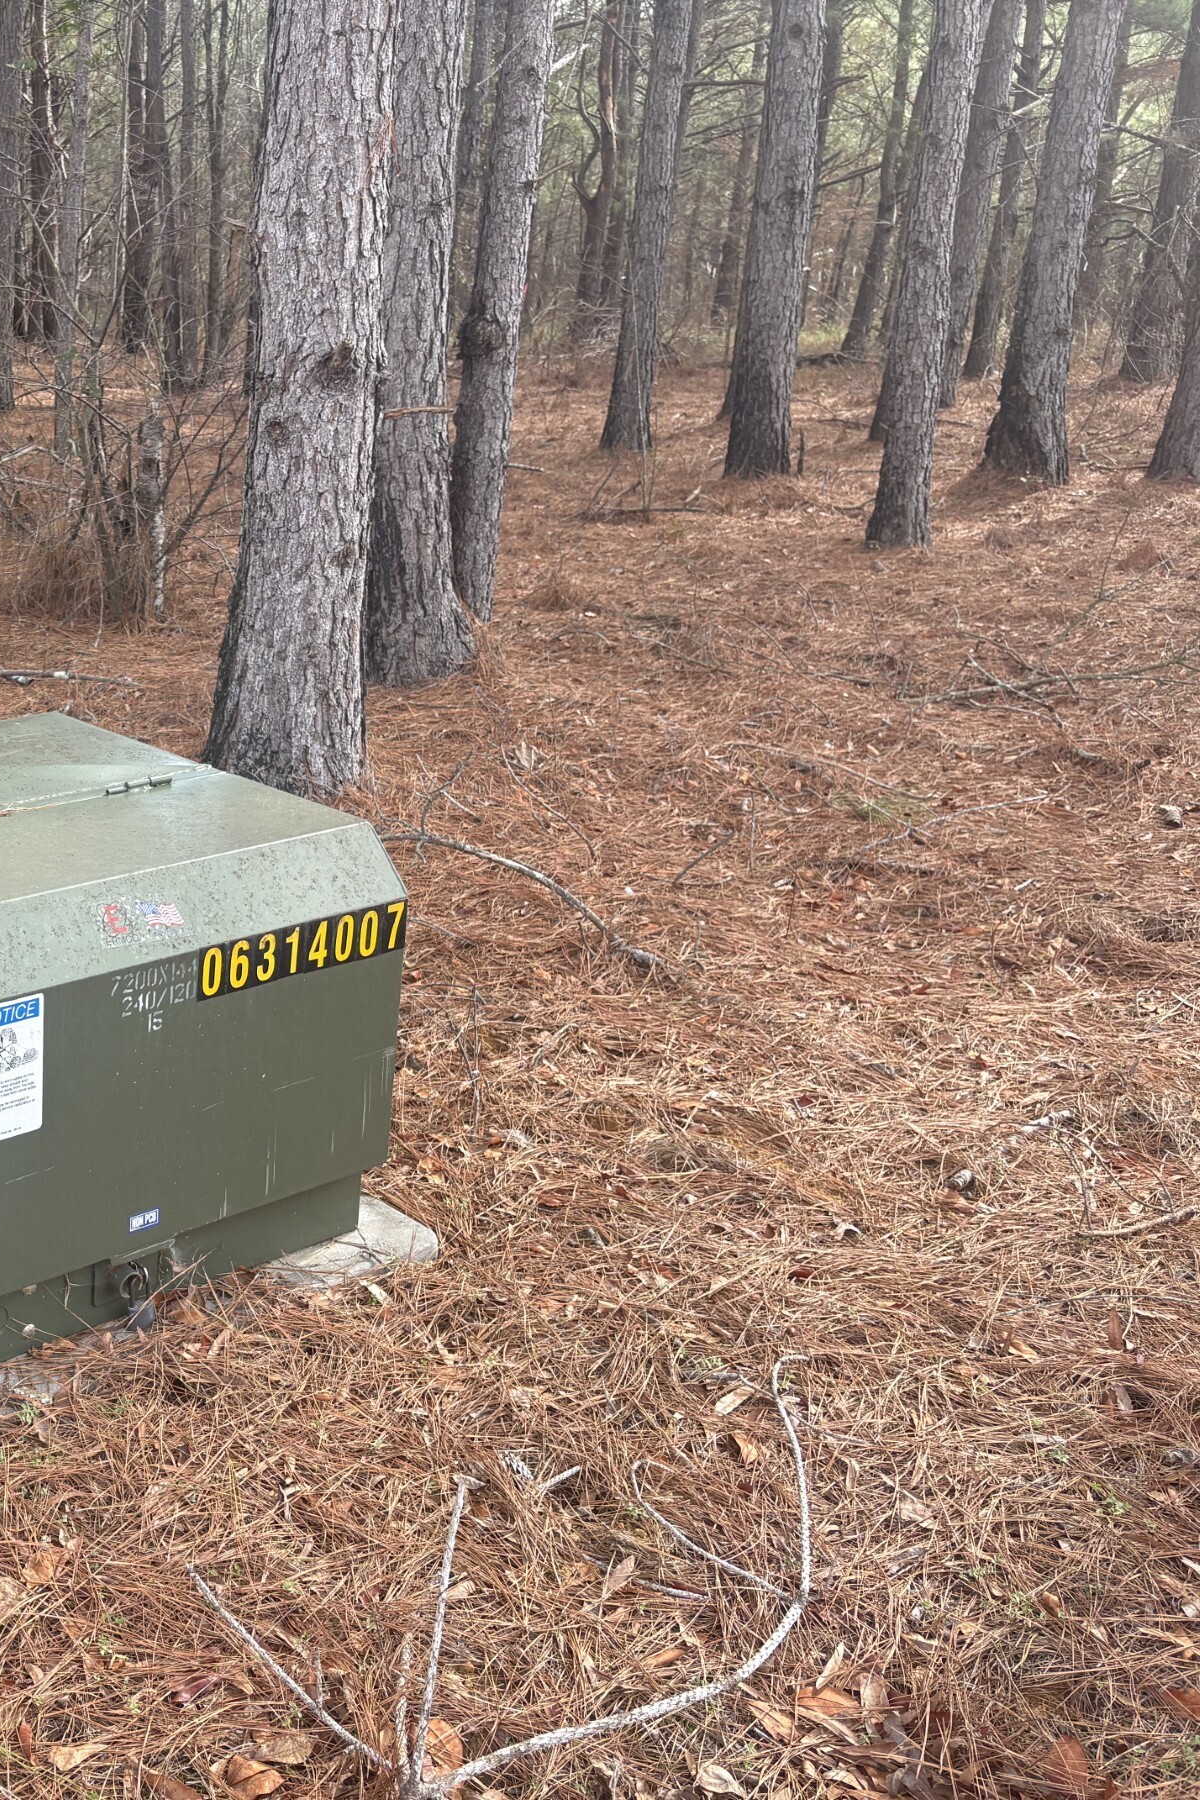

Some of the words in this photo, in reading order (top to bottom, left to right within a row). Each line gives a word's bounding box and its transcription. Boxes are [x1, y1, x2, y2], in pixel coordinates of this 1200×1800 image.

[202, 901, 405, 996] 06314007
[122, 980, 197, 1018] 240/120
[148, 1010, 164, 1032] 15
